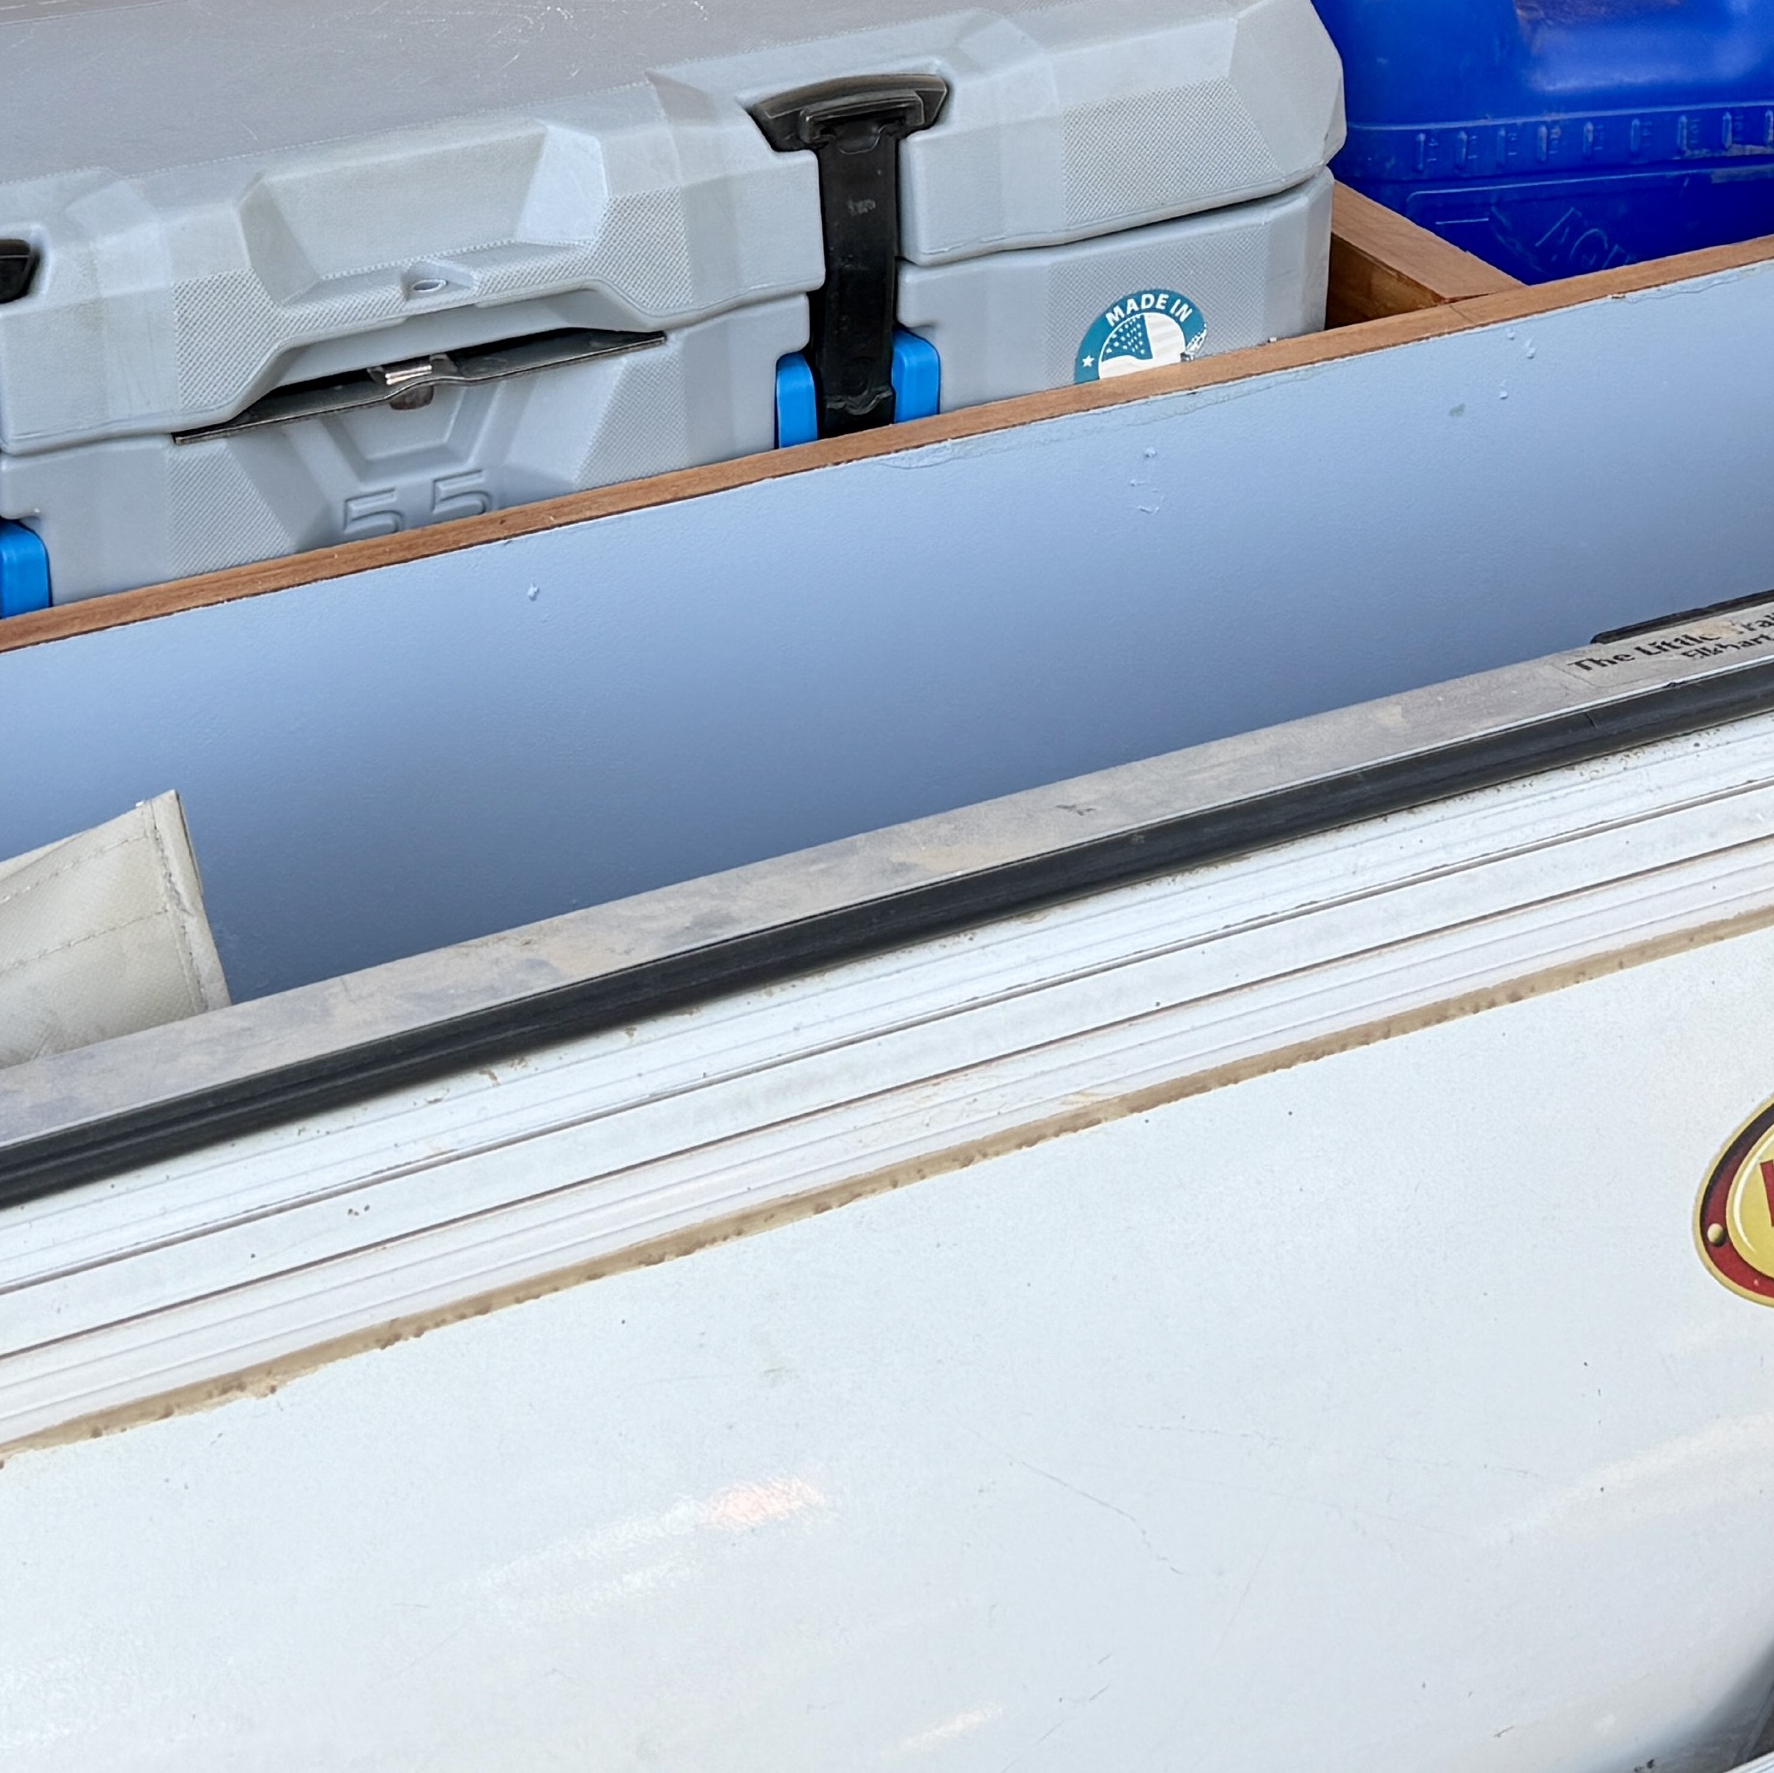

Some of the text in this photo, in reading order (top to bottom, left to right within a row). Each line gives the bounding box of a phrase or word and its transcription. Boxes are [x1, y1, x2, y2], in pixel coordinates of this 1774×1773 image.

[1105, 293, 1193, 327] MADE IN
[343, 468, 493, 534] 55
[1567, 653, 1635, 671] The
